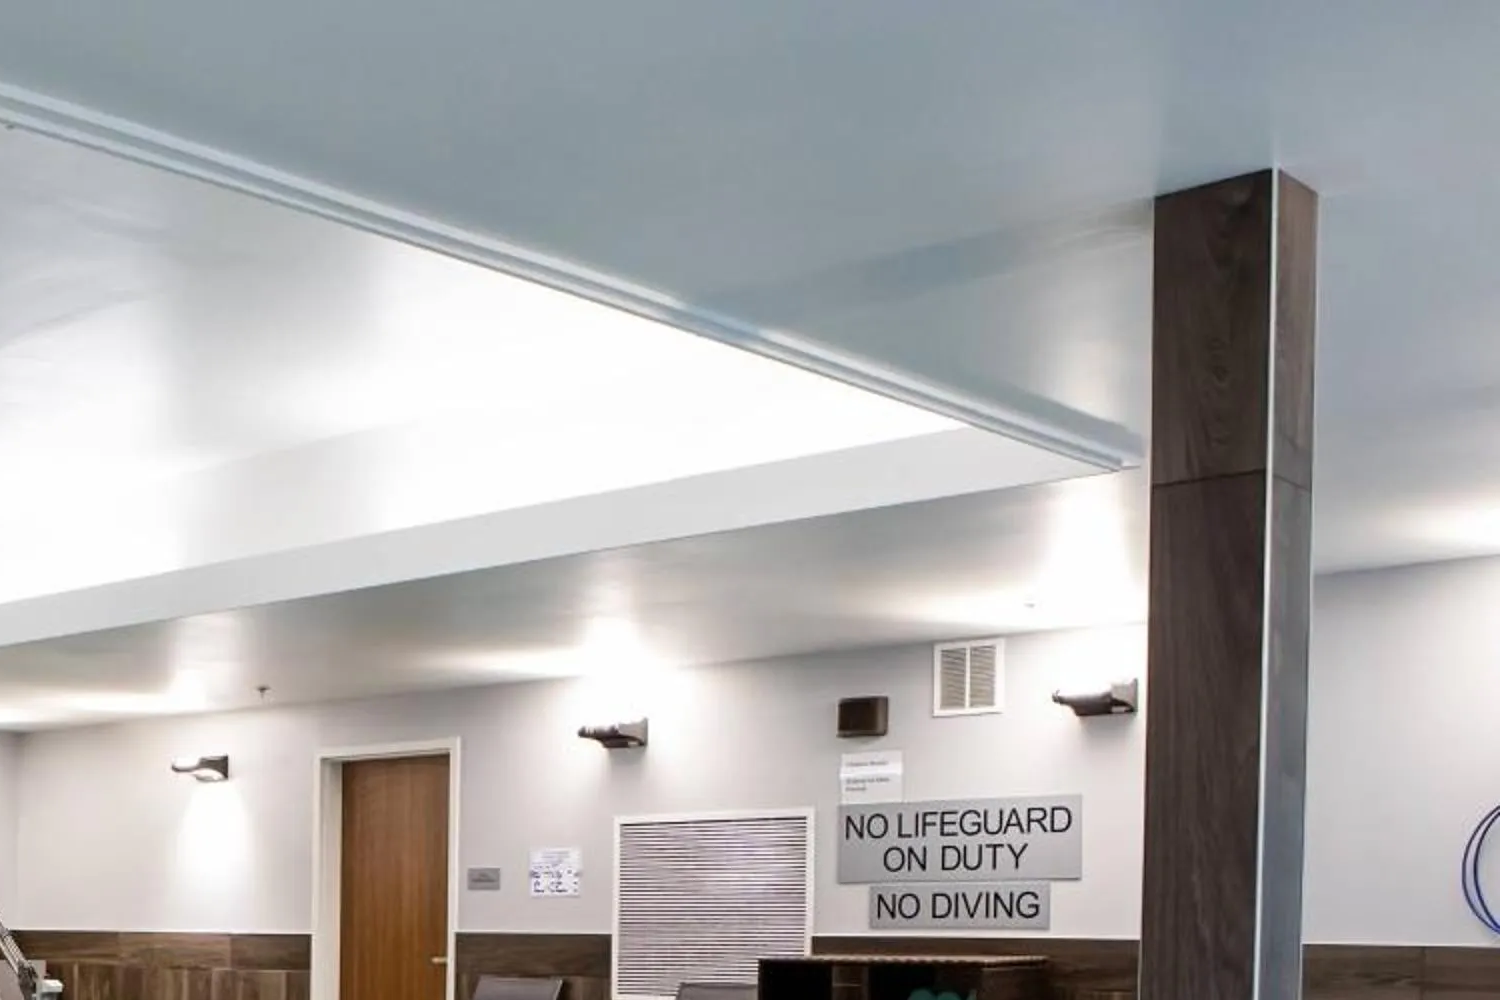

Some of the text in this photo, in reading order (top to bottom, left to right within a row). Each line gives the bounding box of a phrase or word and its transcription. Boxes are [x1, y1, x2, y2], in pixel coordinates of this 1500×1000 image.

[845, 806, 1073, 841] NO LIFEGUARD
[883, 843, 1029, 872] ON DUTY
[877, 891, 1040, 920] NO DIVING
